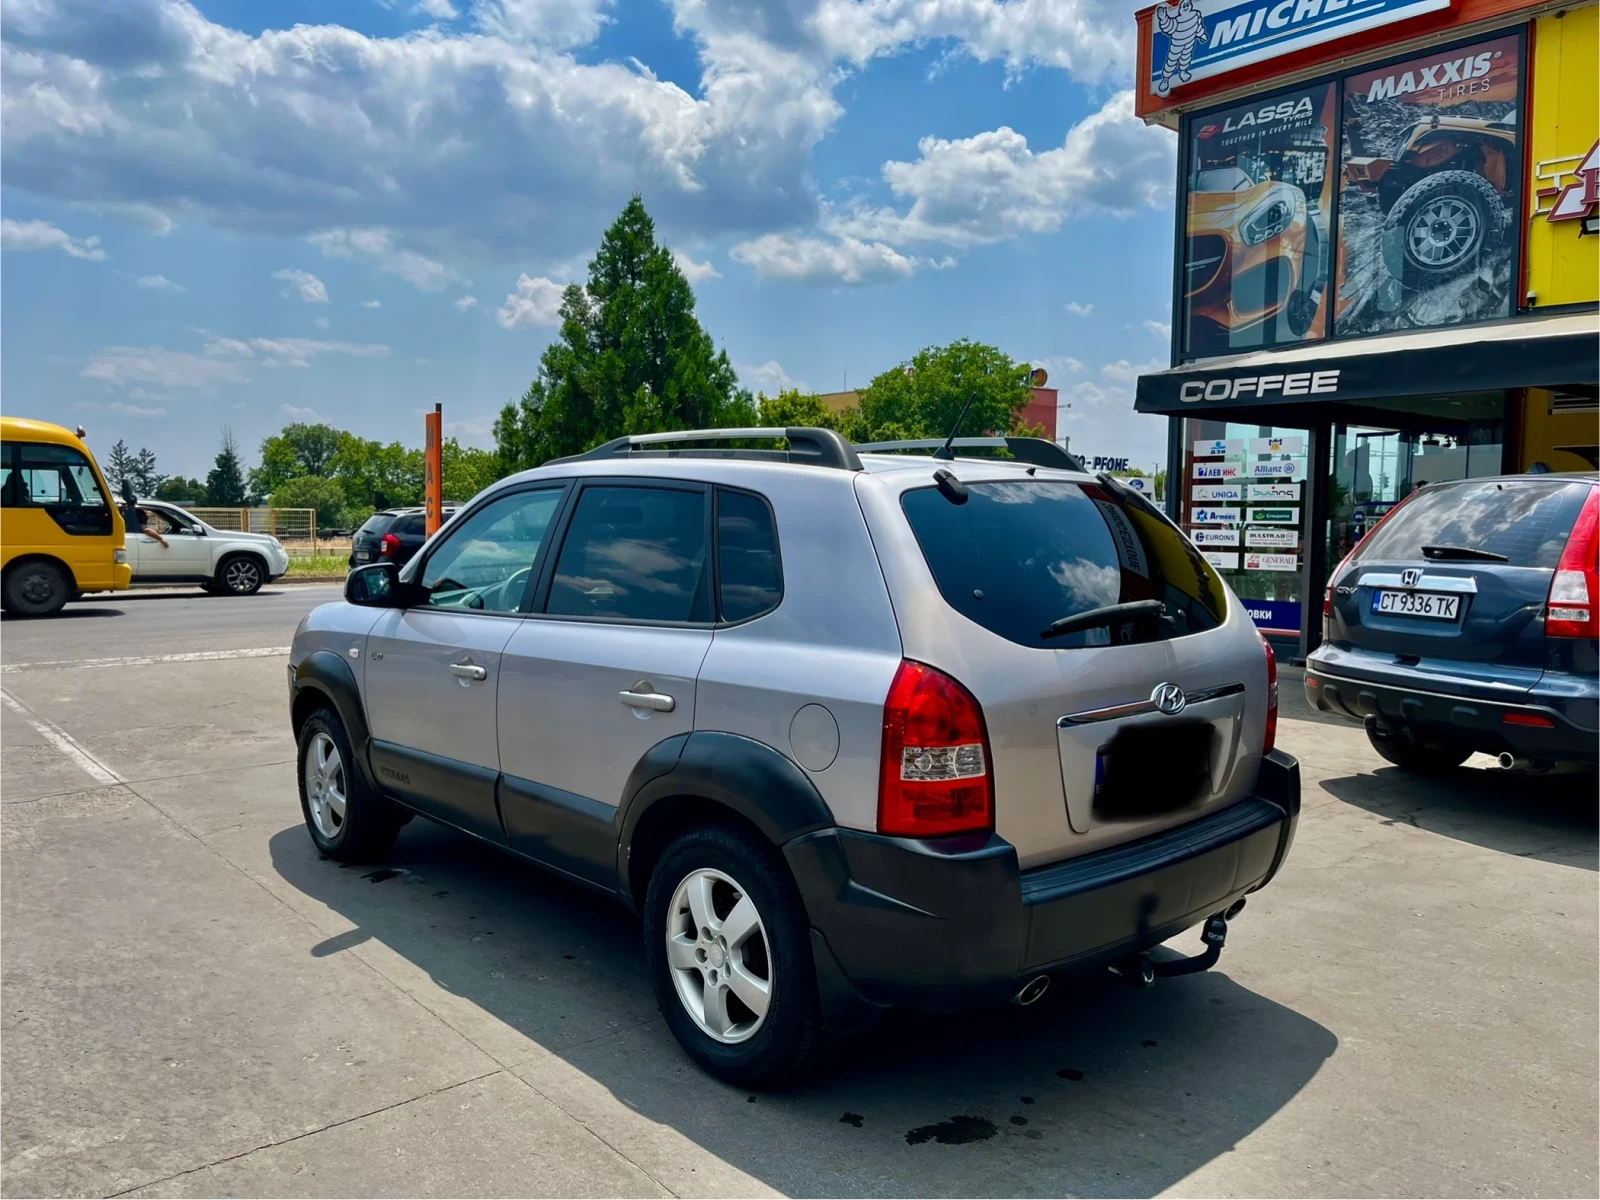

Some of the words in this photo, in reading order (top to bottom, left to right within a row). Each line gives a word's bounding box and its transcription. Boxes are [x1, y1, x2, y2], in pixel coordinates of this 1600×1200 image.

[1209, 0, 1368, 49] MICH
[1438, 78, 1490, 101] TIRES
[1222, 96, 1313, 133] LASSA
[1283, 110, 1313, 123] TYRES
[1221, 133, 1255, 147] TOGETHER
[1258, 129, 1266, 137] IN
[1269, 124, 1292, 135] EVERY
[1295, 118, 1313, 128] MILE
[1180, 370, 1340, 403] COFFEE
[1254, 464, 1283, 473] Allianz
[1211, 491, 1239, 499] UNIQA
[1262, 556, 1294, 565] GENERALI
[1381, 593, 1398, 610] CT
[1400, 594, 1432, 613] 9336
[1437, 597, 1456, 616] TK
